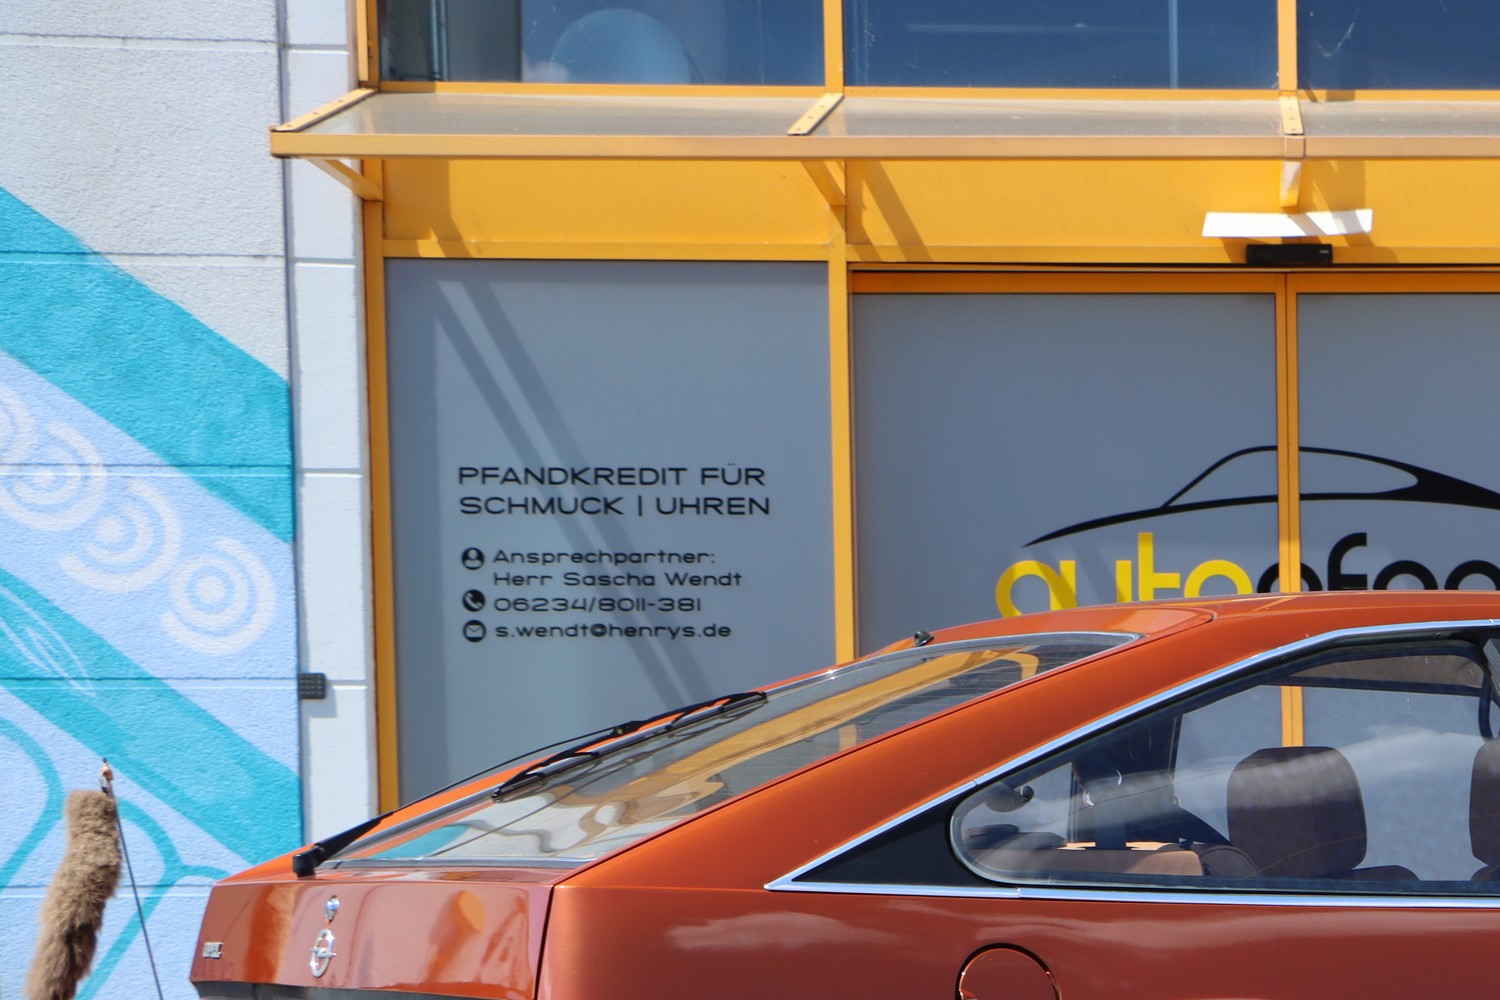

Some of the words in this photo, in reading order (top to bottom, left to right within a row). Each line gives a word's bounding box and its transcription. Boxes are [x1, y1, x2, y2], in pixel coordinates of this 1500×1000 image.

[457, 466, 689, 487] PFANDKREDIT
[700, 462, 766, 486] FÜR
[459, 496, 625, 516] SCHMUCK
[655, 496, 771, 516] UHREN
[492, 549, 716, 567] Ansprechpartner:
[493, 571, 554, 587] Herr
[562, 571, 656, 587] Sascha
[664, 571, 743, 587] Wendt
[493, 597, 702, 614] 06234/8011-381
[494, 622, 732, 641] s.wendt@henrys.de
